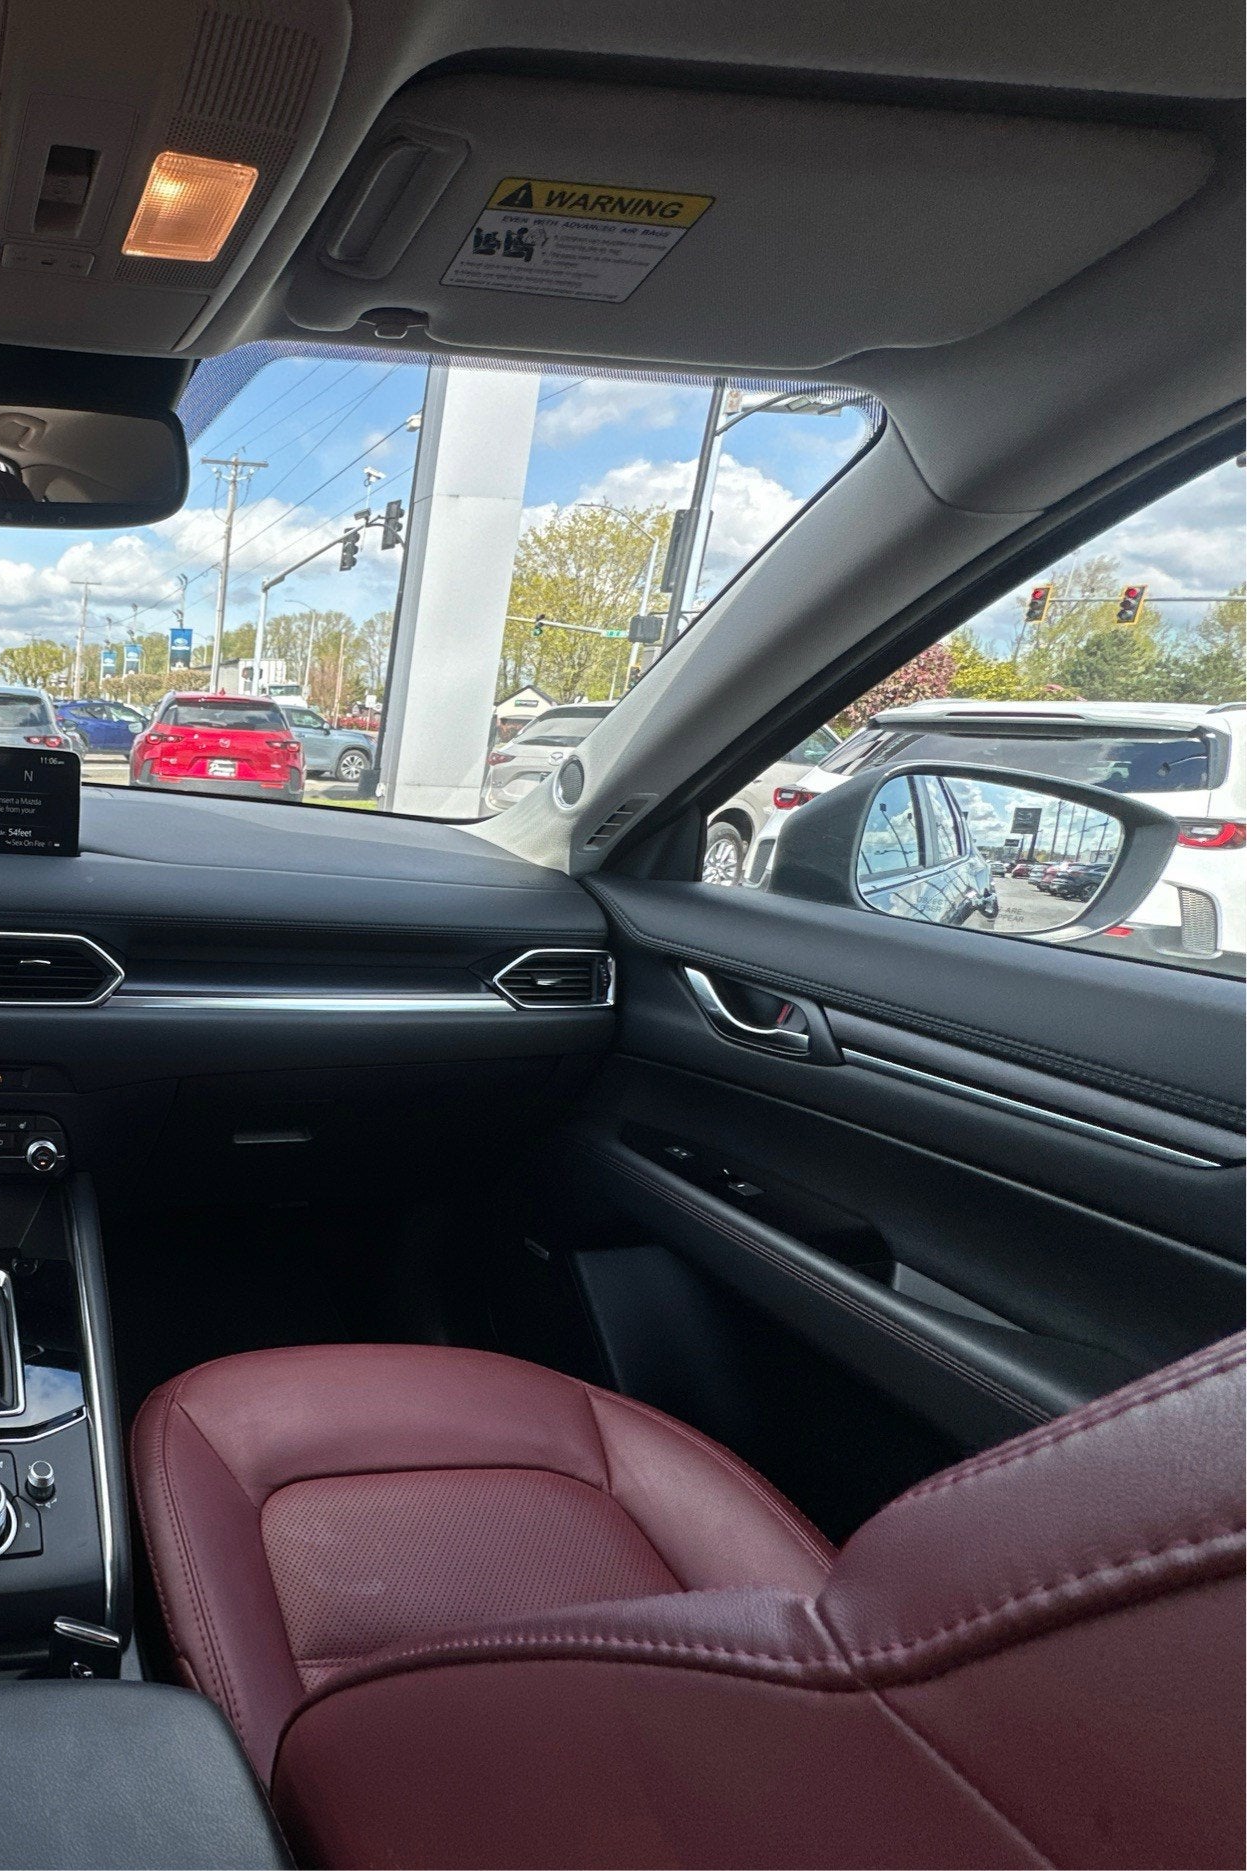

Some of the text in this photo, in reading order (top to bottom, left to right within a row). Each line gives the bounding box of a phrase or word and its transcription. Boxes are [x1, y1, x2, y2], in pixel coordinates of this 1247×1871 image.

[545, 190, 684, 219] WARNING
[502, 215, 529, 224] EVEN
[534, 218, 559, 226] WITH
[561, 221, 616, 232] ADVANCED
[24, 770, 34, 782] N
[20, 798, 42, 806] Mazda
[1005, 907, 1023, 915] ARE
